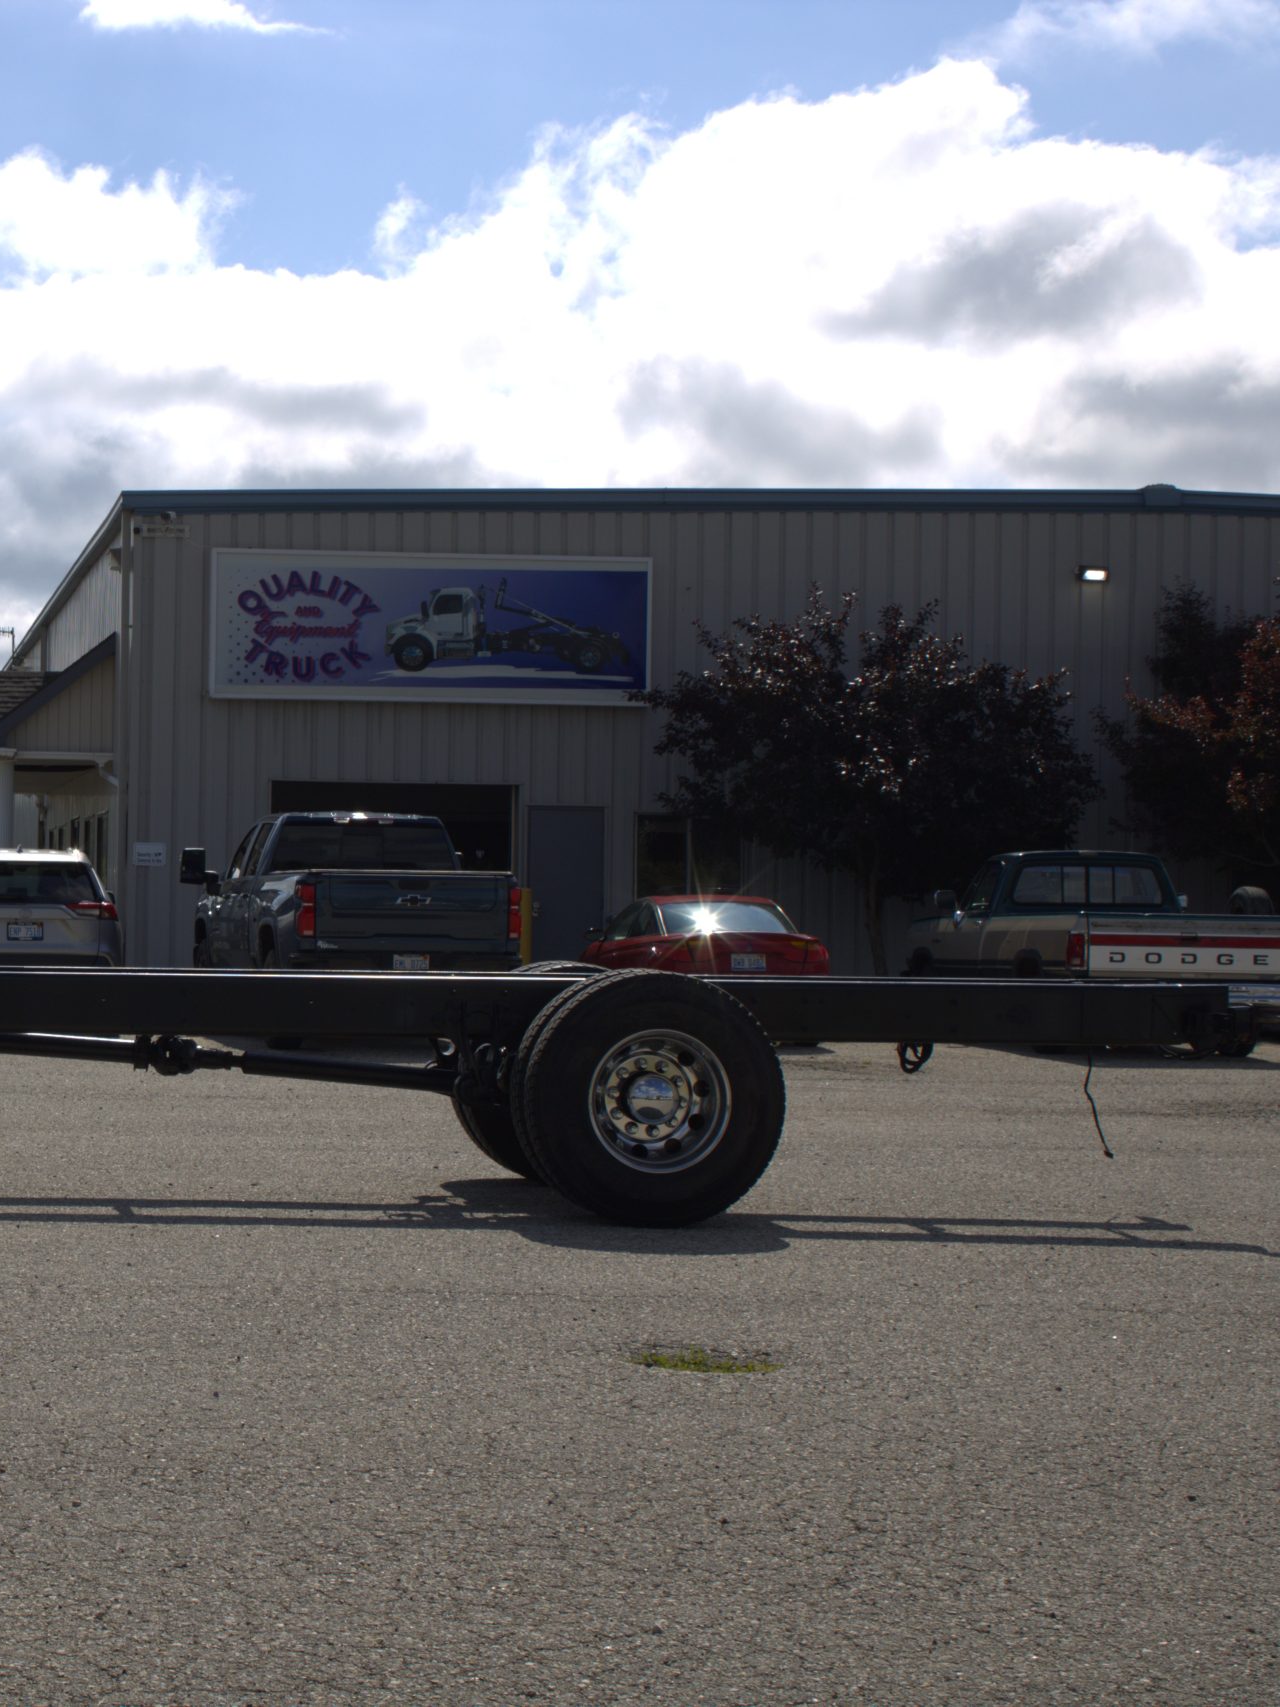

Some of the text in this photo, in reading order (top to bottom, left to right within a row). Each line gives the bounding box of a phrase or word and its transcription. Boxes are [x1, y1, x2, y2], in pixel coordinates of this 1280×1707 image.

[238, 570, 382, 617] QUALITY
[294, 605, 324, 618] AND
[254, 607, 362, 644] Equipment
[244, 638, 373, 682] TRUCK
[1109, 951, 1269, 966] DODGE
